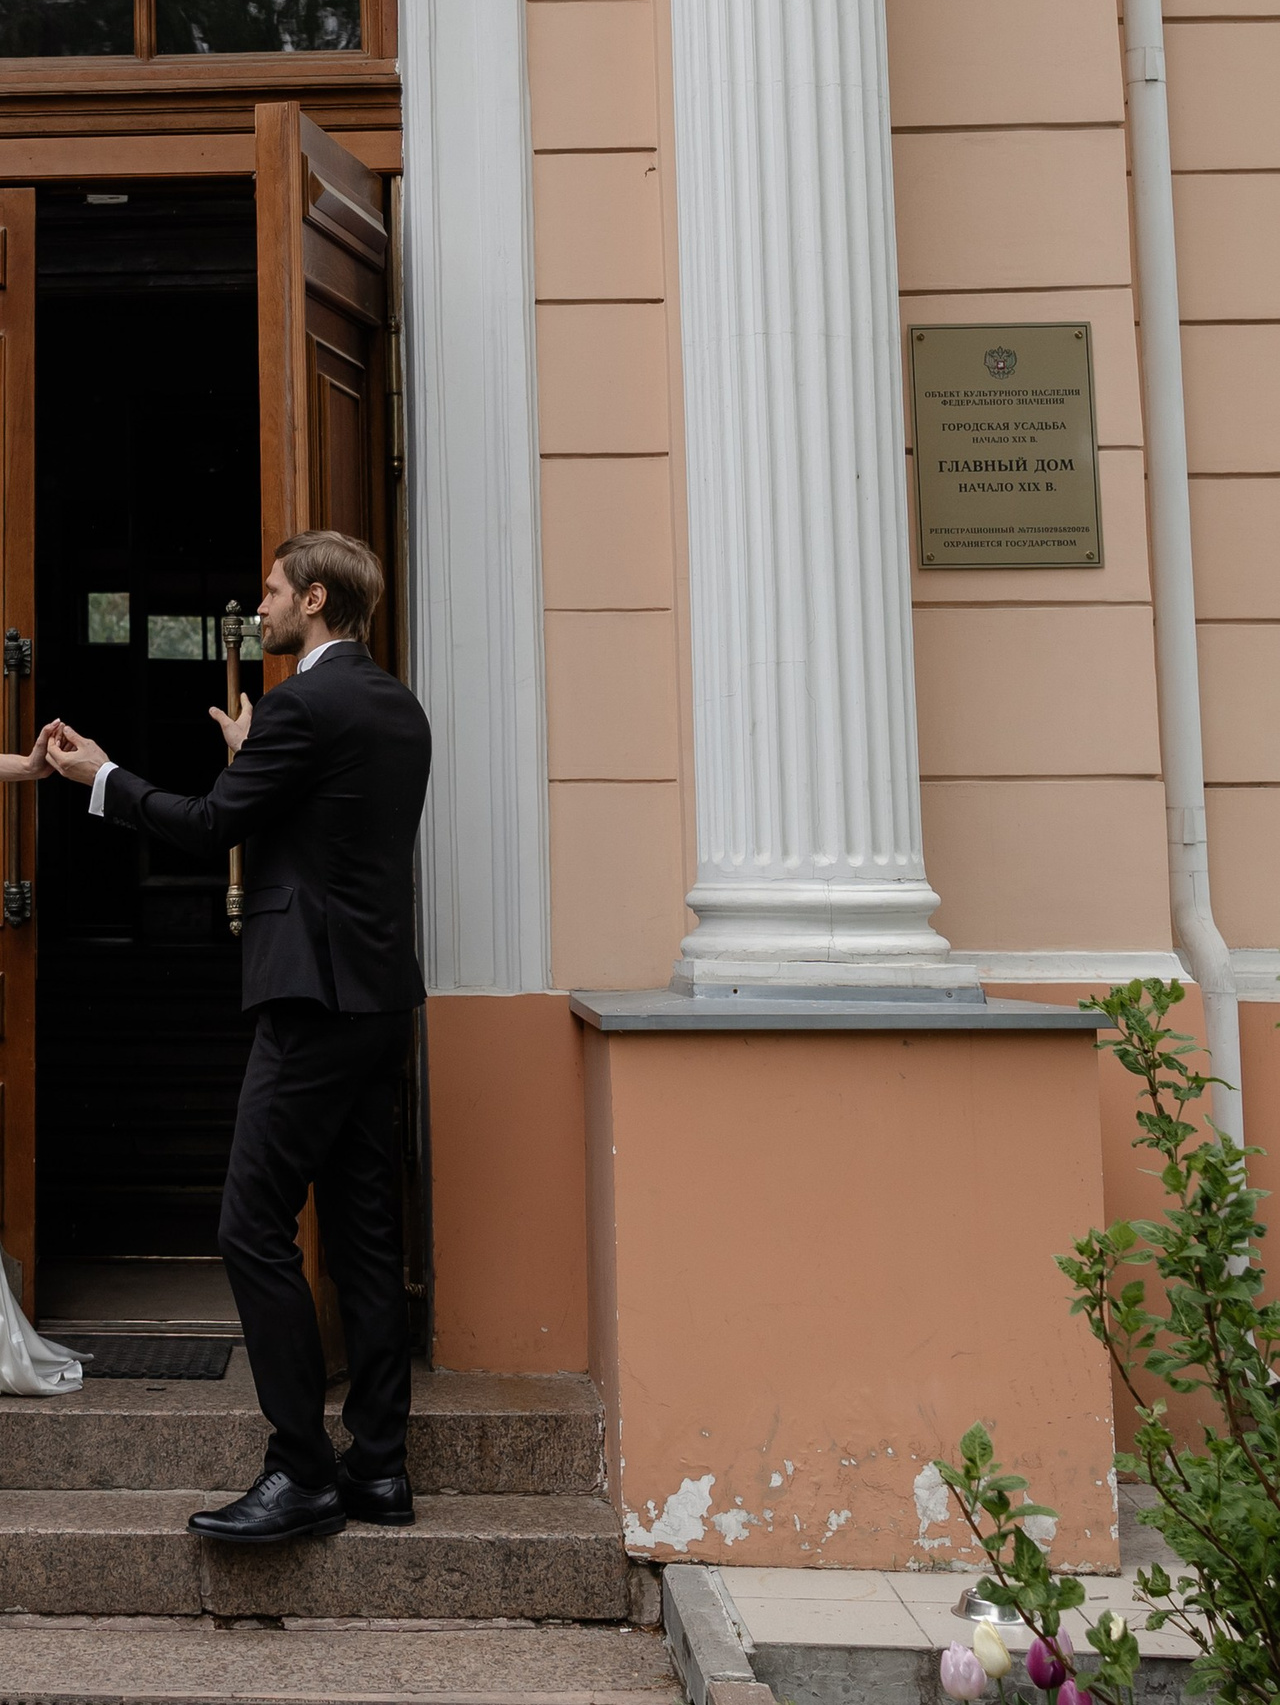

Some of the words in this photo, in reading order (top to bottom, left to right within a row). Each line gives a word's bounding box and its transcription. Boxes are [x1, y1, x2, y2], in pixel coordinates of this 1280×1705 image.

[924, 390, 961, 398] ОБЪЕКТ
[963, 389, 1029, 398] КУЛЬТУРНОГО
[1031, 389, 1081, 397] НАСЛЕДИЯ
[941, 398, 1014, 406] ФЕДЕРАЛЬНОГО
[1016, 397, 1065, 405] ЗНАЧЕНИЯ
[942, 422, 1010, 431] ГОРОДСКАЯ
[1014, 421, 1067, 431] УСАДЬБА
[972, 436, 1010, 444] НАЧАЛО
[938, 457, 1028, 473] ГЛАВНЫЙ
[1034, 458, 1076, 473] ДОМ
[959, 483, 1014, 493] НАЧАЛО
[1018, 482, 1041, 492] XIX
[1045, 482, 1057, 492] В.
[929, 526, 1015, 534] РЕГИСТРАЦИОННЫЙ
